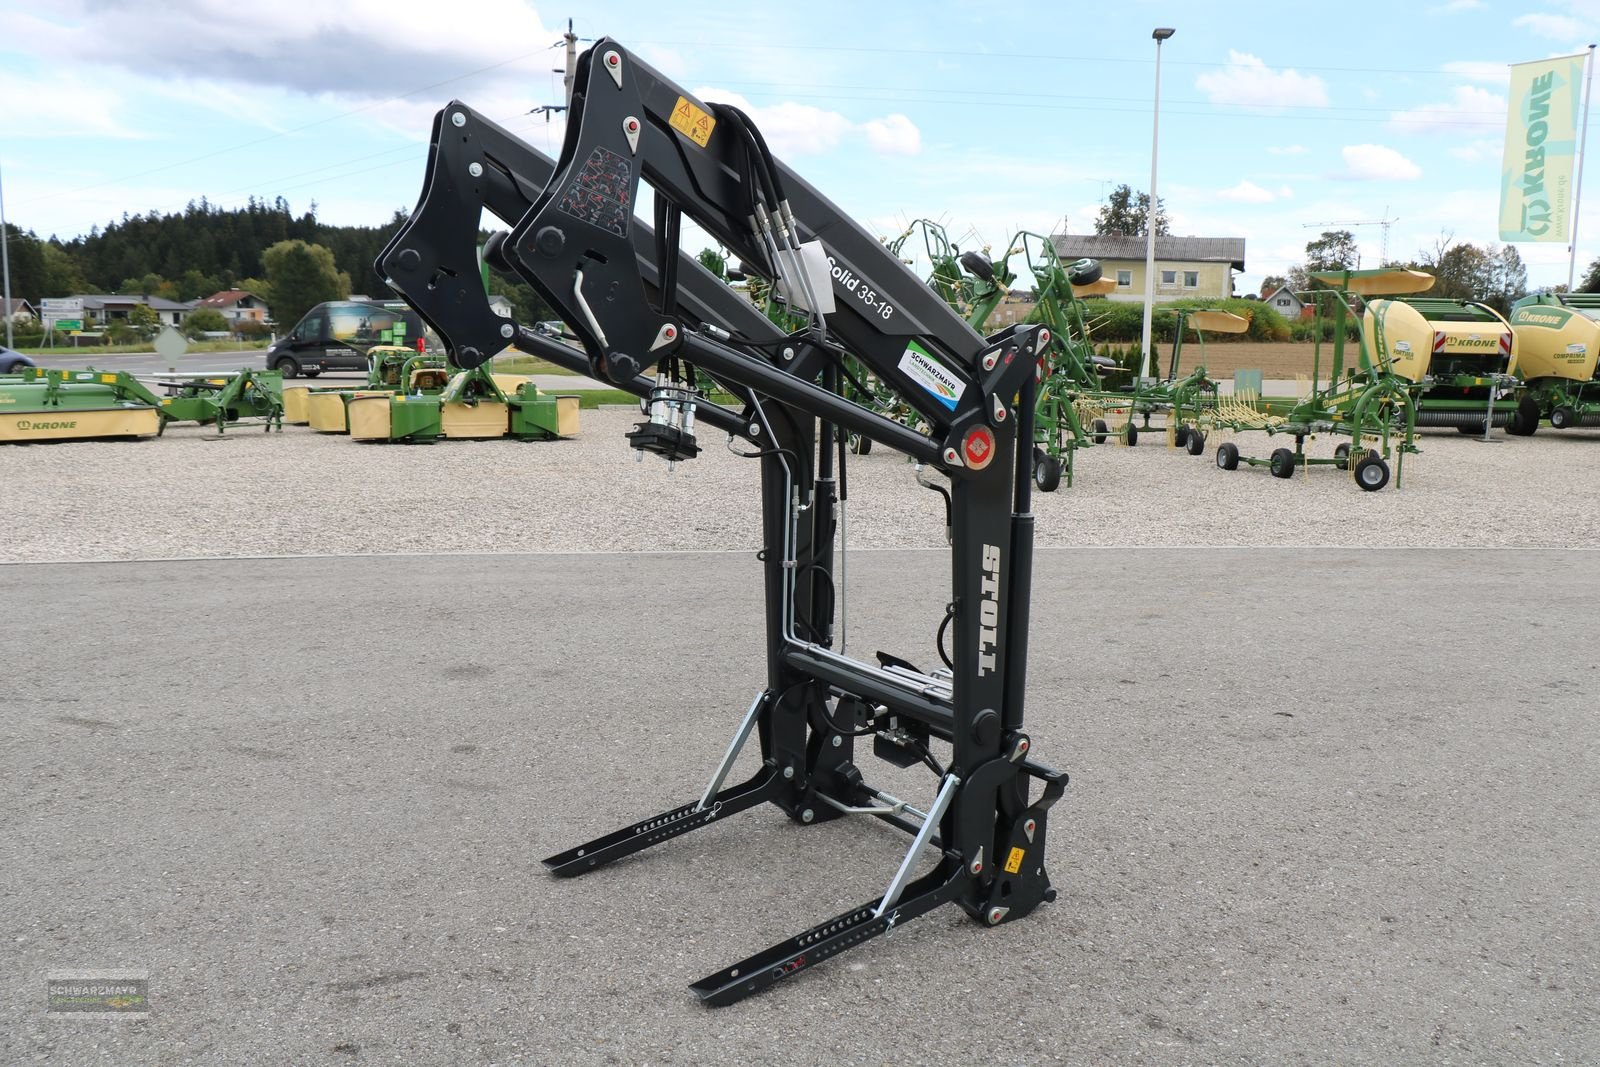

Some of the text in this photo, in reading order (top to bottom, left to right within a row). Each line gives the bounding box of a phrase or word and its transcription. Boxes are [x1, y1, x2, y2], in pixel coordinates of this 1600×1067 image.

[827, 256, 893, 319] Solid 35-18
[1526, 313, 1562, 324] KRONE
[1457, 339, 1497, 347] KRONE
[911, 352, 956, 391] SCHWARZMAYR
[32, 421, 77, 430] KRONE
[978, 543, 1001, 677] STOLL
